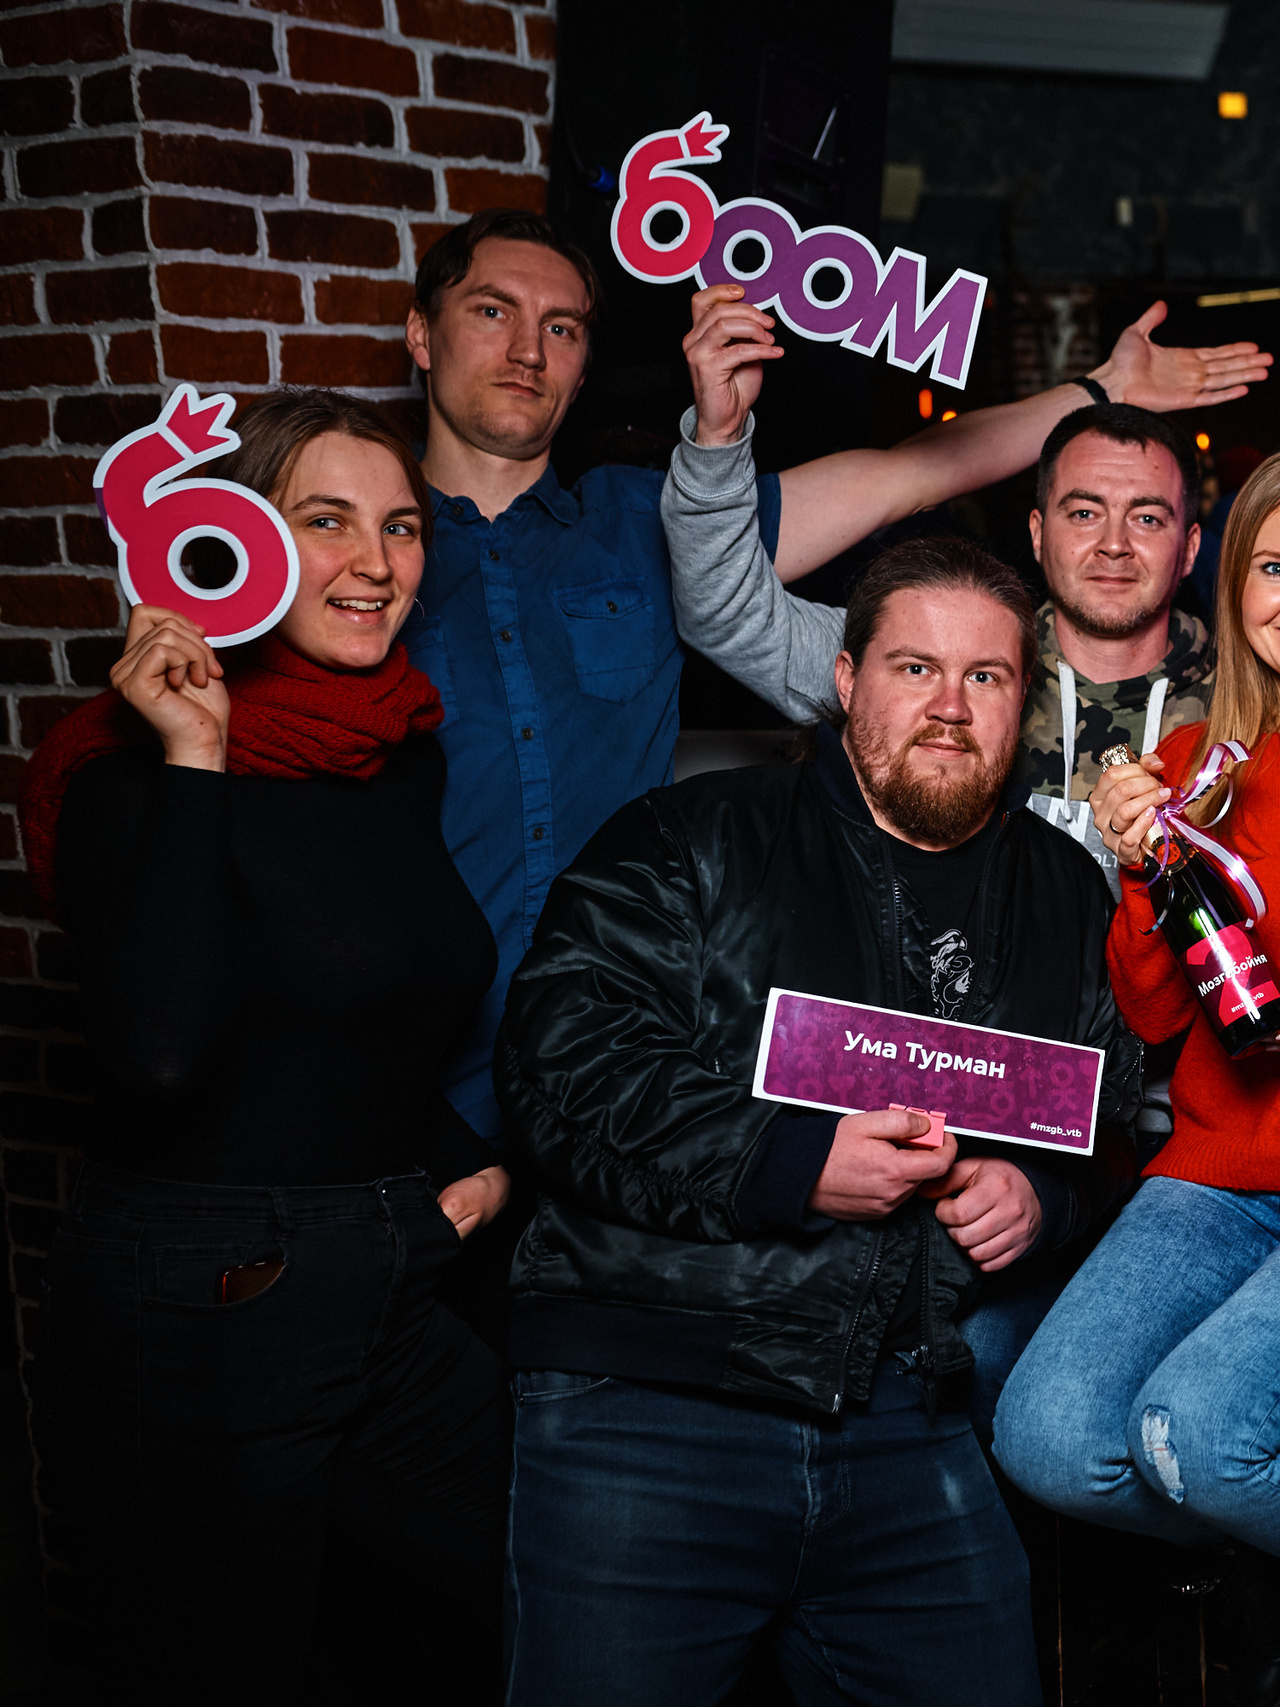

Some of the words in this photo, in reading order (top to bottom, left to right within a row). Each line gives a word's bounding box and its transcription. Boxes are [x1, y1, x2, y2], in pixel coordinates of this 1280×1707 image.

[1231, 992, 1264, 1012] #mz_vtb
[843, 1030, 898, 1059] Ума
[905, 1041, 1006, 1079] Турман
[1030, 1121, 1082, 1138] #mzgb_vtb
